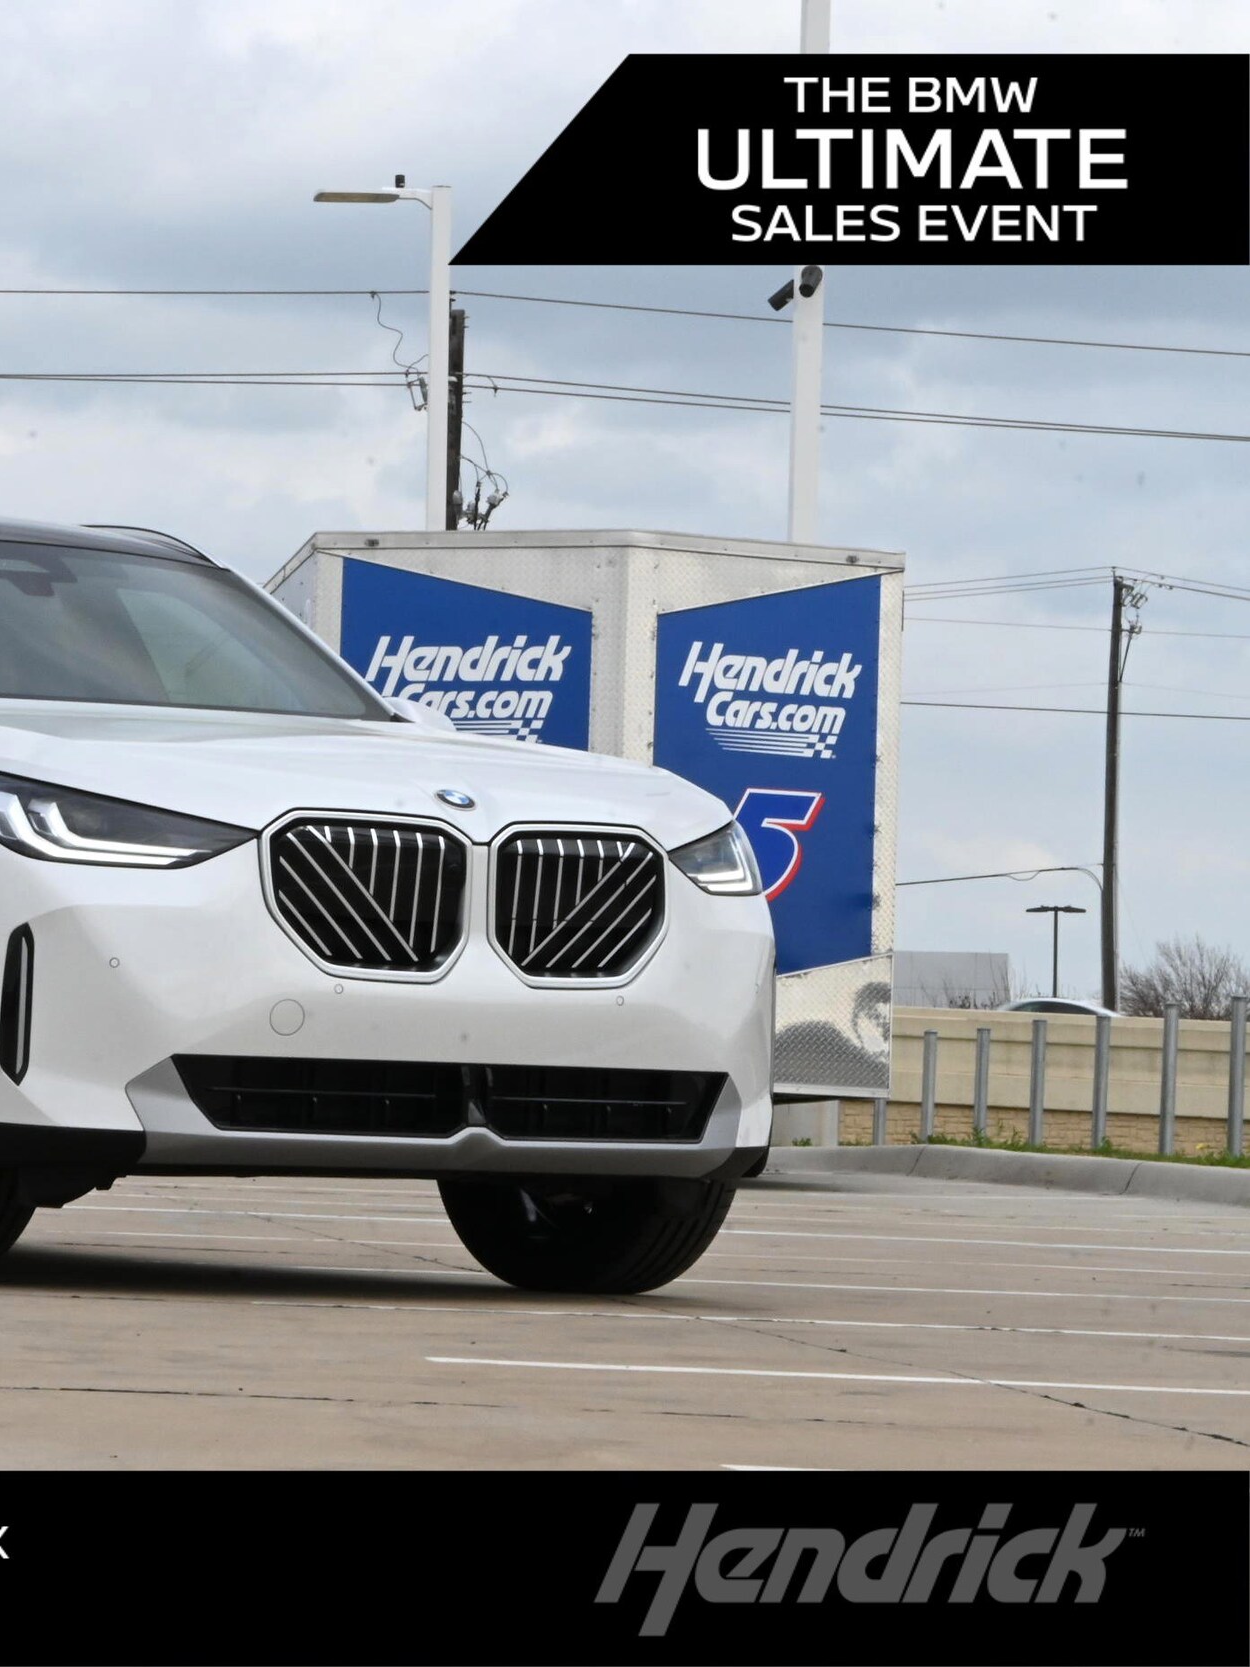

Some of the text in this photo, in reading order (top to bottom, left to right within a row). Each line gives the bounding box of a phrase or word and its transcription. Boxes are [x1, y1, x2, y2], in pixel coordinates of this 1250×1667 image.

[365, 635, 572, 697] Hendrick
[678, 641, 863, 704] Hendrick
[706, 691, 846, 735] Cars.com
[733, 787, 826, 902] 5
